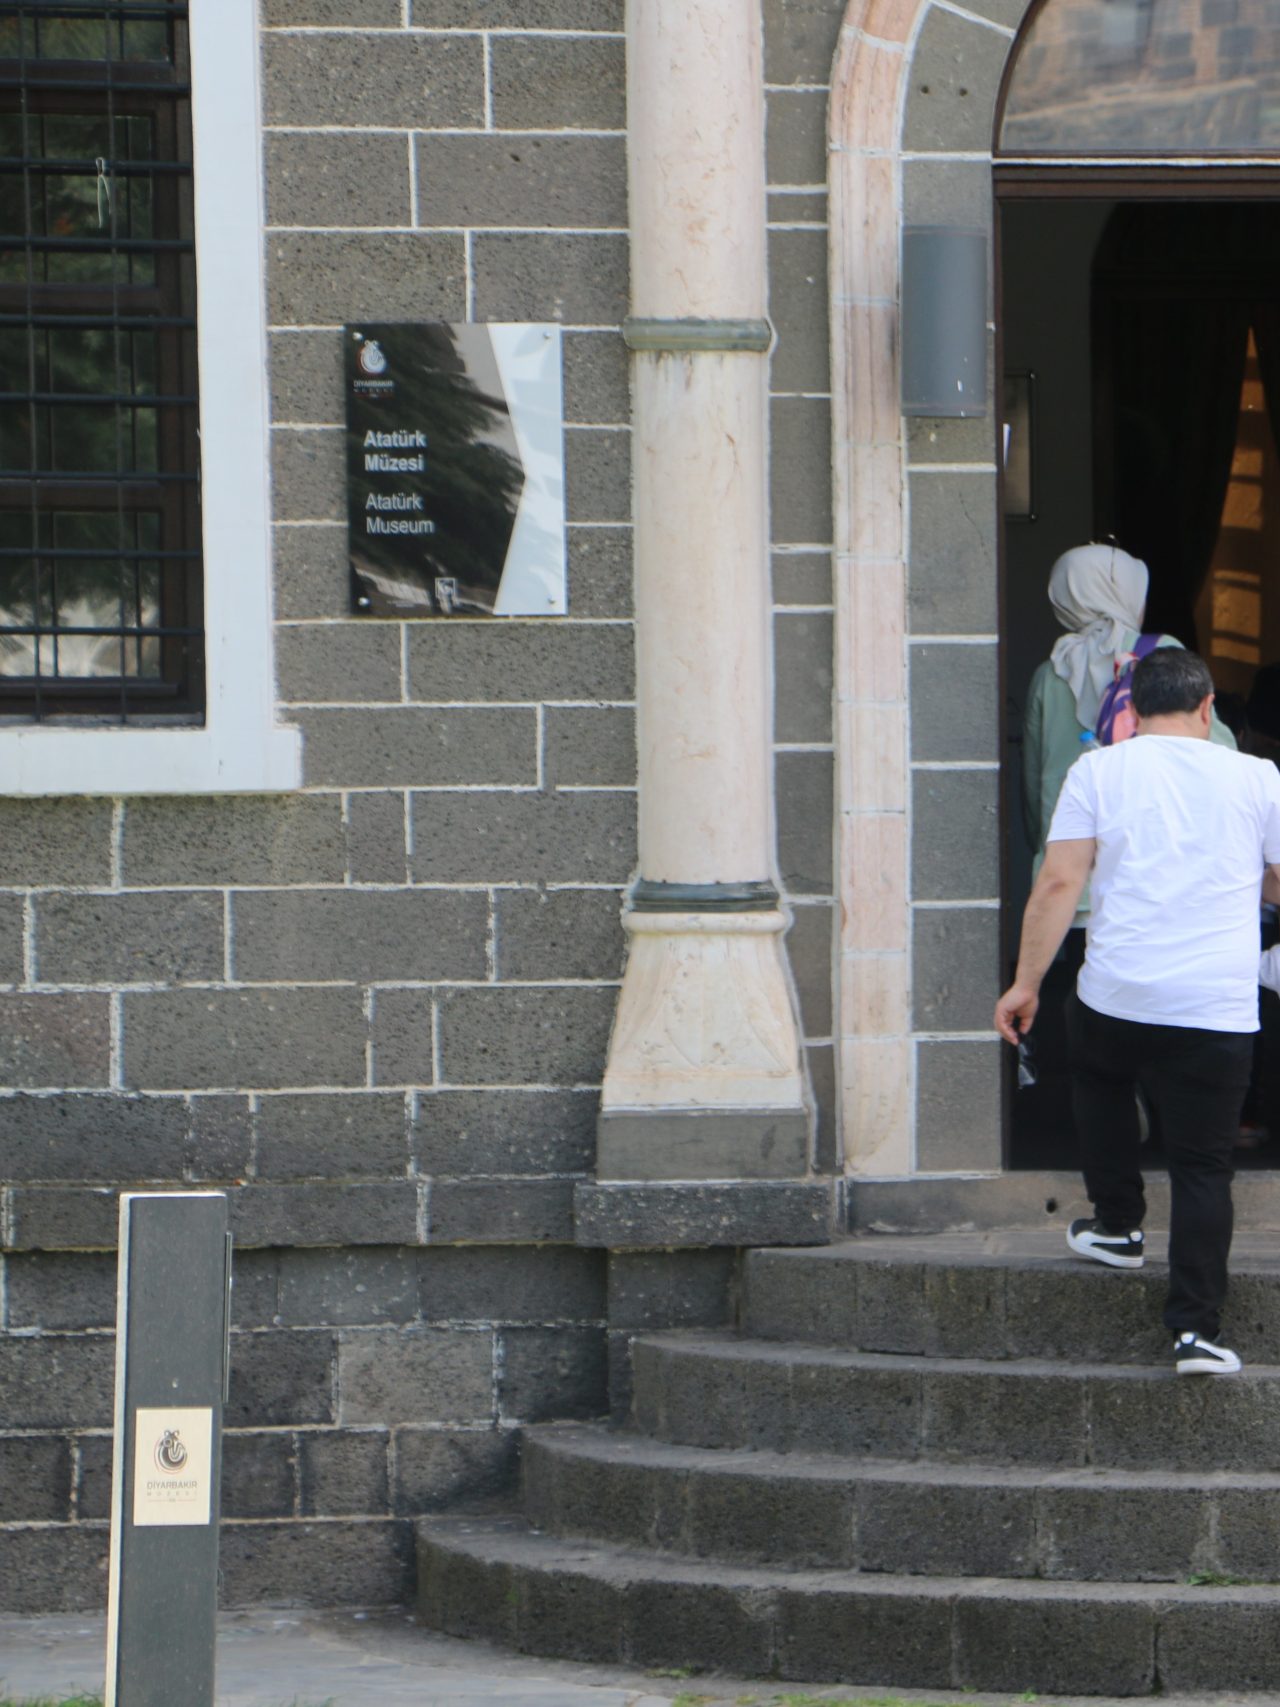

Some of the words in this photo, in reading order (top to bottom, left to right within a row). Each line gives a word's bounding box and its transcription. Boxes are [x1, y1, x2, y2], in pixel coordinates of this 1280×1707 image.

[363, 429, 427, 448] Atatürk
[364, 453, 424, 472] Müzesi
[365, 492, 423, 510] Atatürk
[366, 516, 434, 534] Museum
